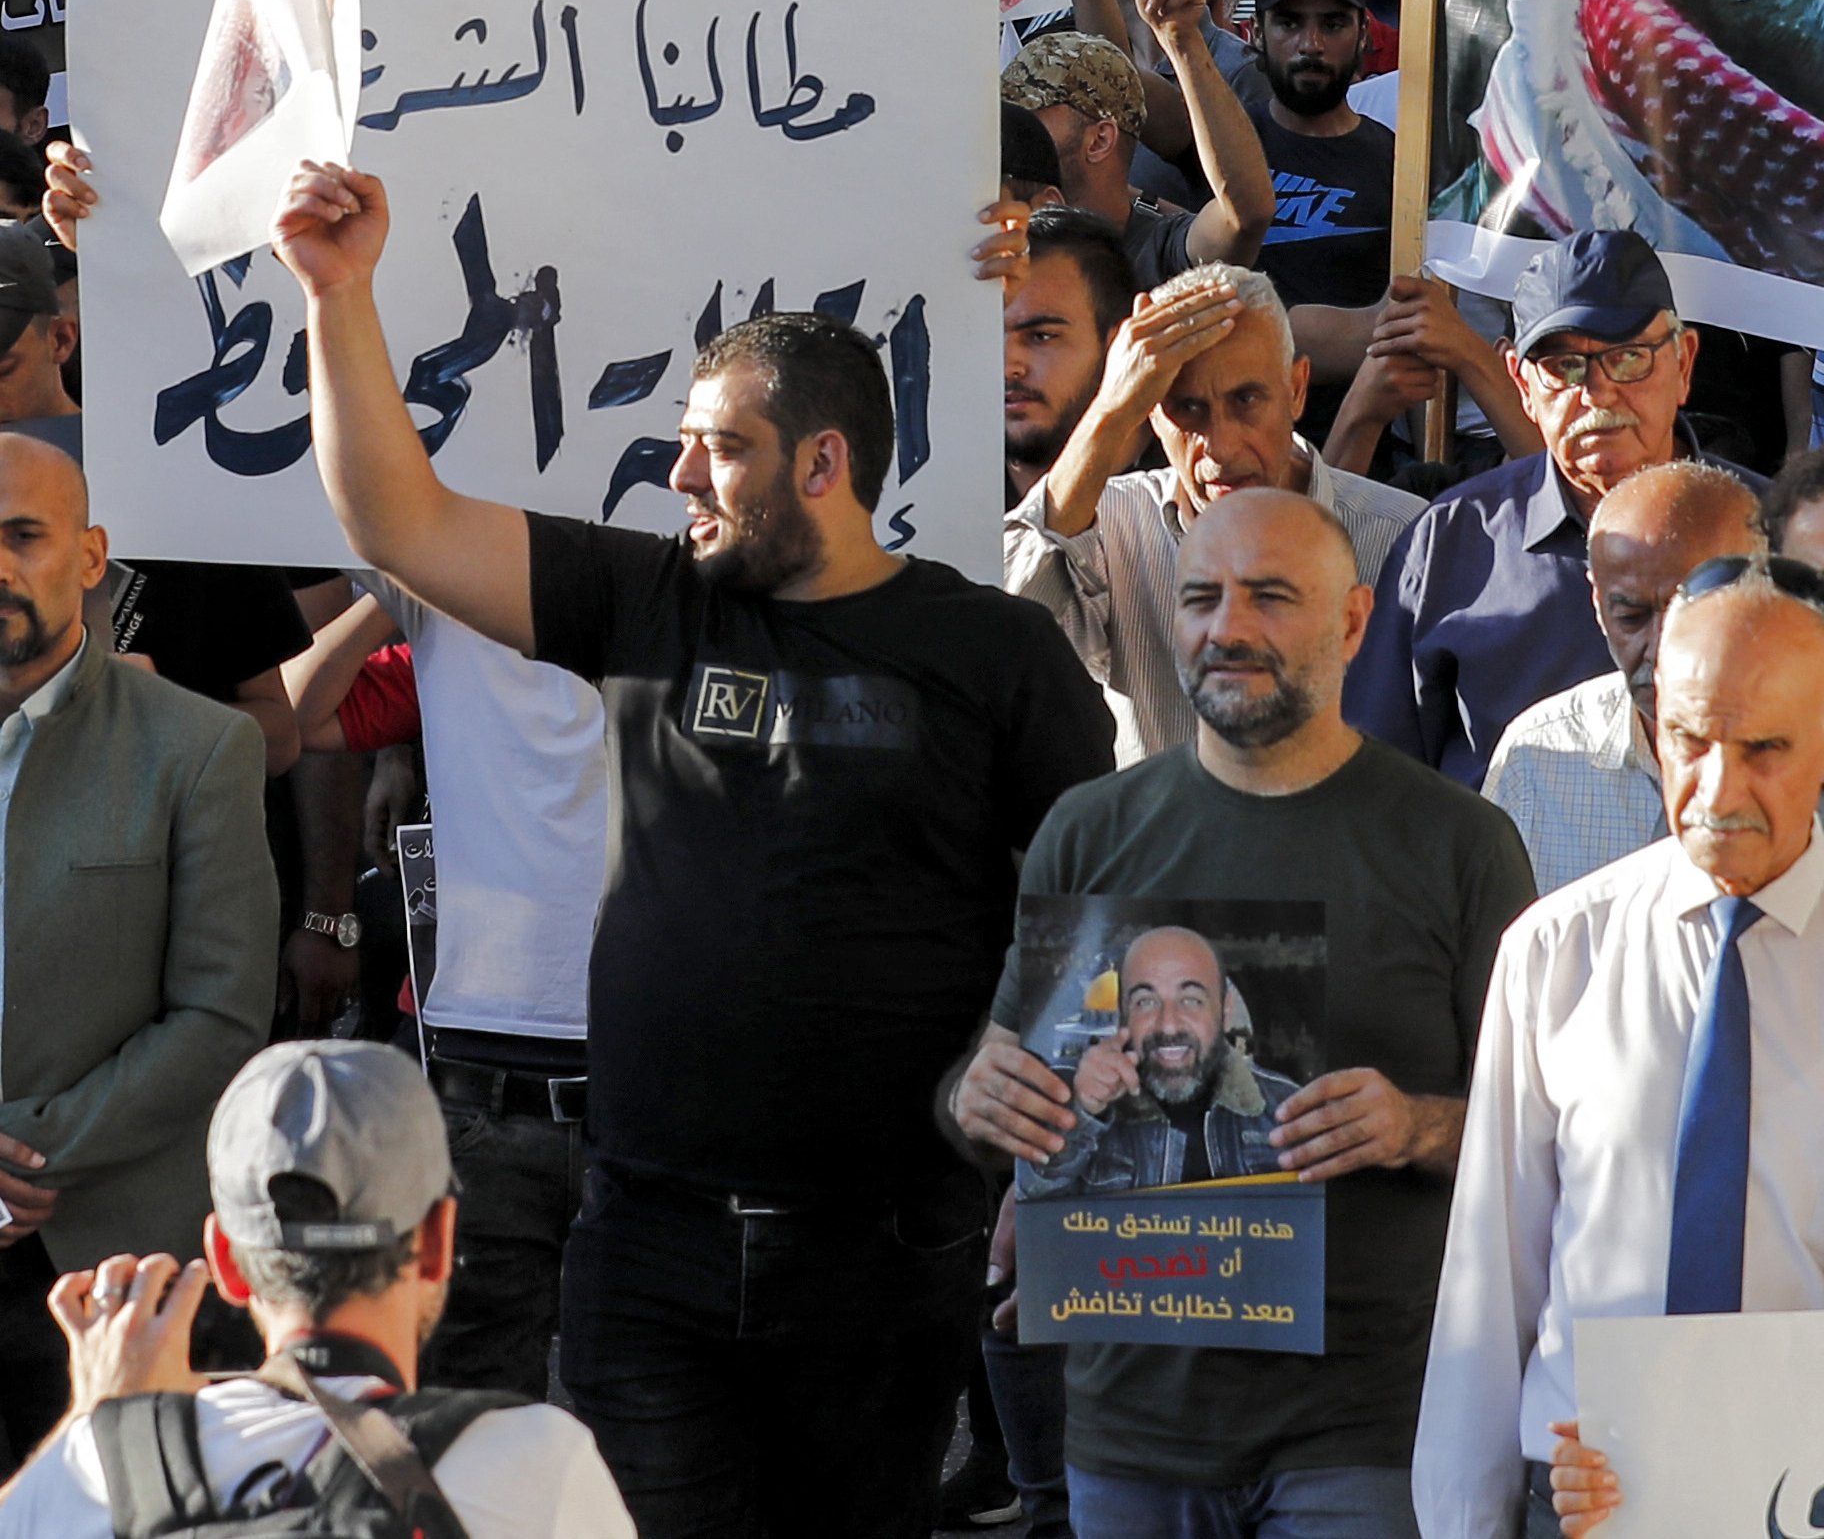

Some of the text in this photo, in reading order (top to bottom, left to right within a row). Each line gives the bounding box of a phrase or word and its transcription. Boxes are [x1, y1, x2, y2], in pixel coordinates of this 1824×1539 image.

[702, 682, 759, 722] RV
[1063, 1209, 1295, 1242] هذه البلد تستحق منك
[1098, 1245, 1243, 1289] أن تضحي
[1050, 1287, 1295, 1325] صعد خطابك تخافش
